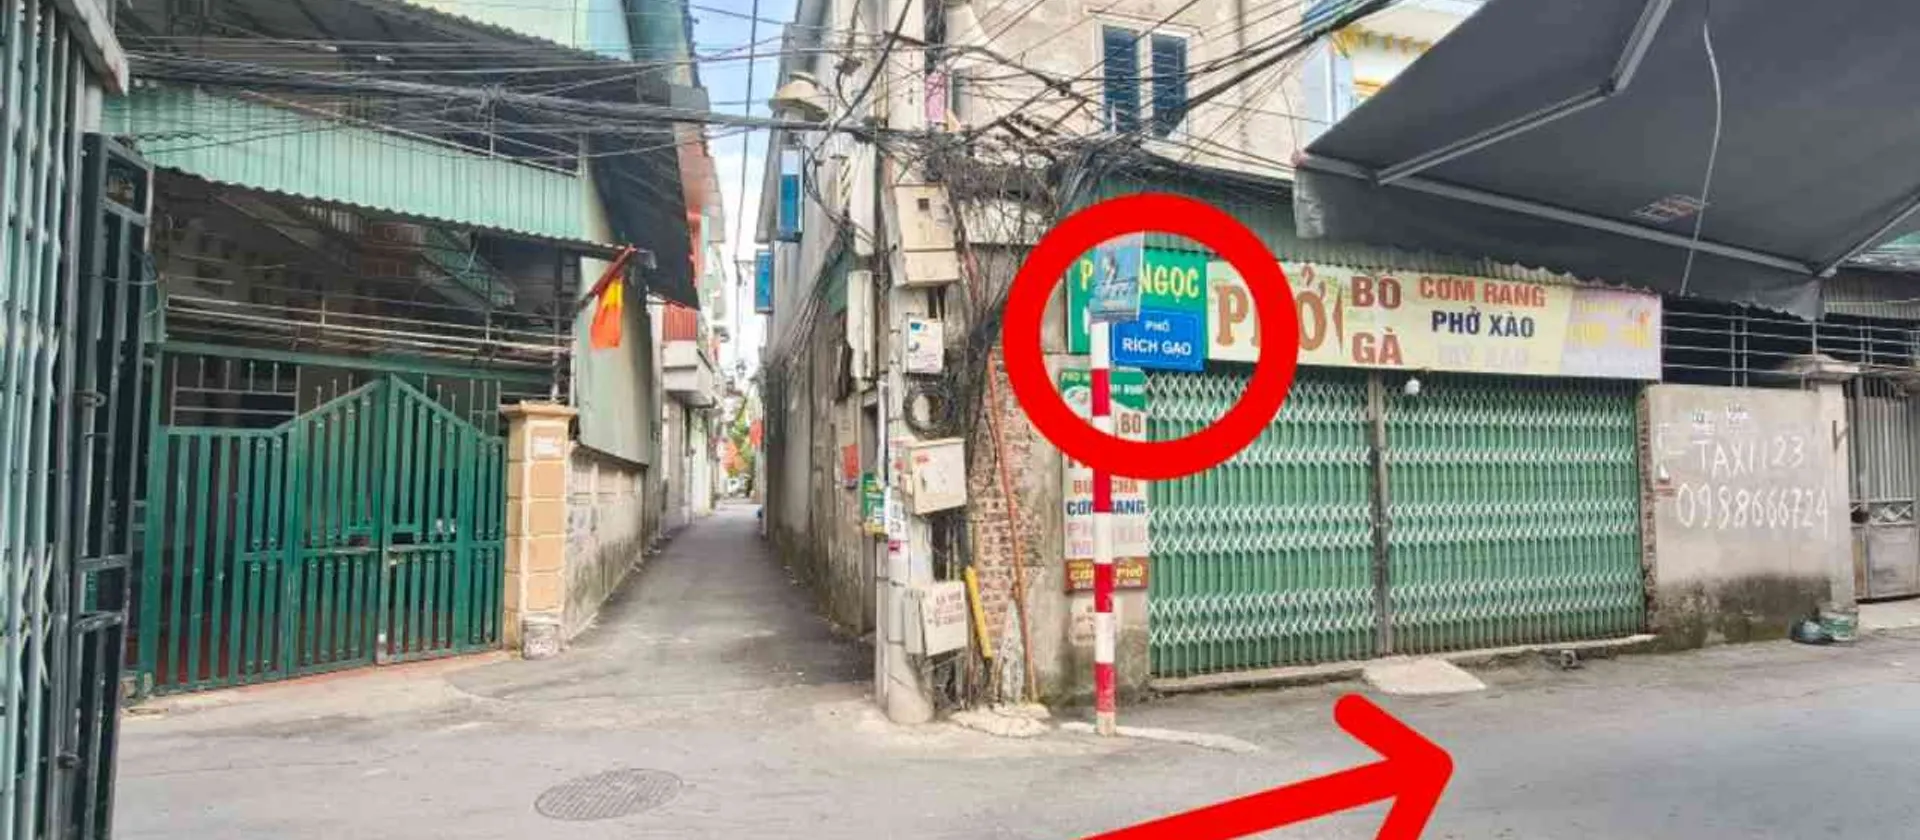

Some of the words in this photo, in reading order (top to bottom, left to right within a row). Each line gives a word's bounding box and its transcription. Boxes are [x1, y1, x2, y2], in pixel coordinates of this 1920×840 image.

[1214, 264, 1327, 351] PỞ
[1419, 275, 1476, 301] CƠM
[1484, 280, 1546, 308] RANG
[1352, 327, 1403, 365] GÀ
